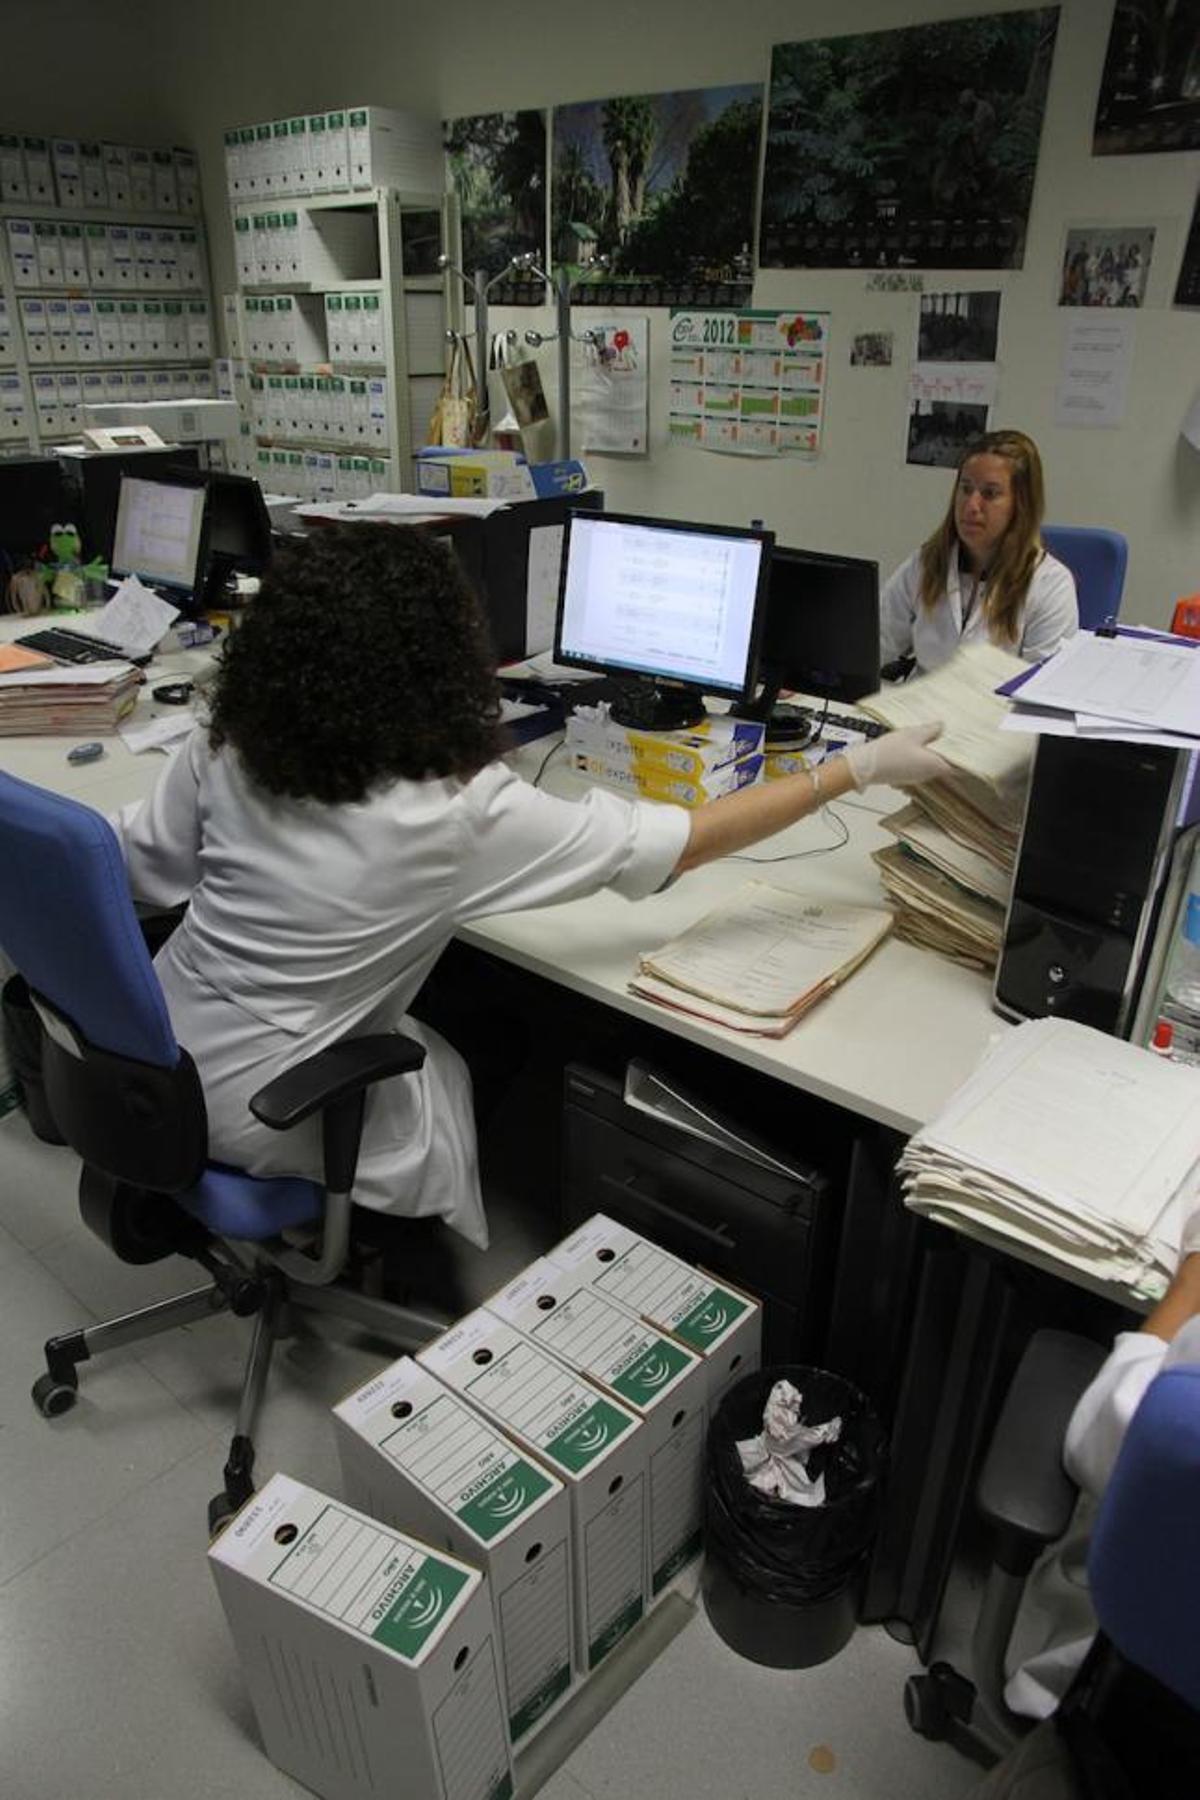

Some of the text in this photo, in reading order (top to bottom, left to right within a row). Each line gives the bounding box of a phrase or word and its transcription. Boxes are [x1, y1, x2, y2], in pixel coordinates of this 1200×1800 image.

[703, 318, 735, 344] 2012
[671, 1290, 706, 1324] ARCHIVO
[610, 1340, 649, 1377] ARCHIVO
[546, 1400, 588, 1440] ARCHIVO
[459, 1460, 507, 1503] ARCHIVO
[370, 1563, 415, 1621] ARCHIVO
